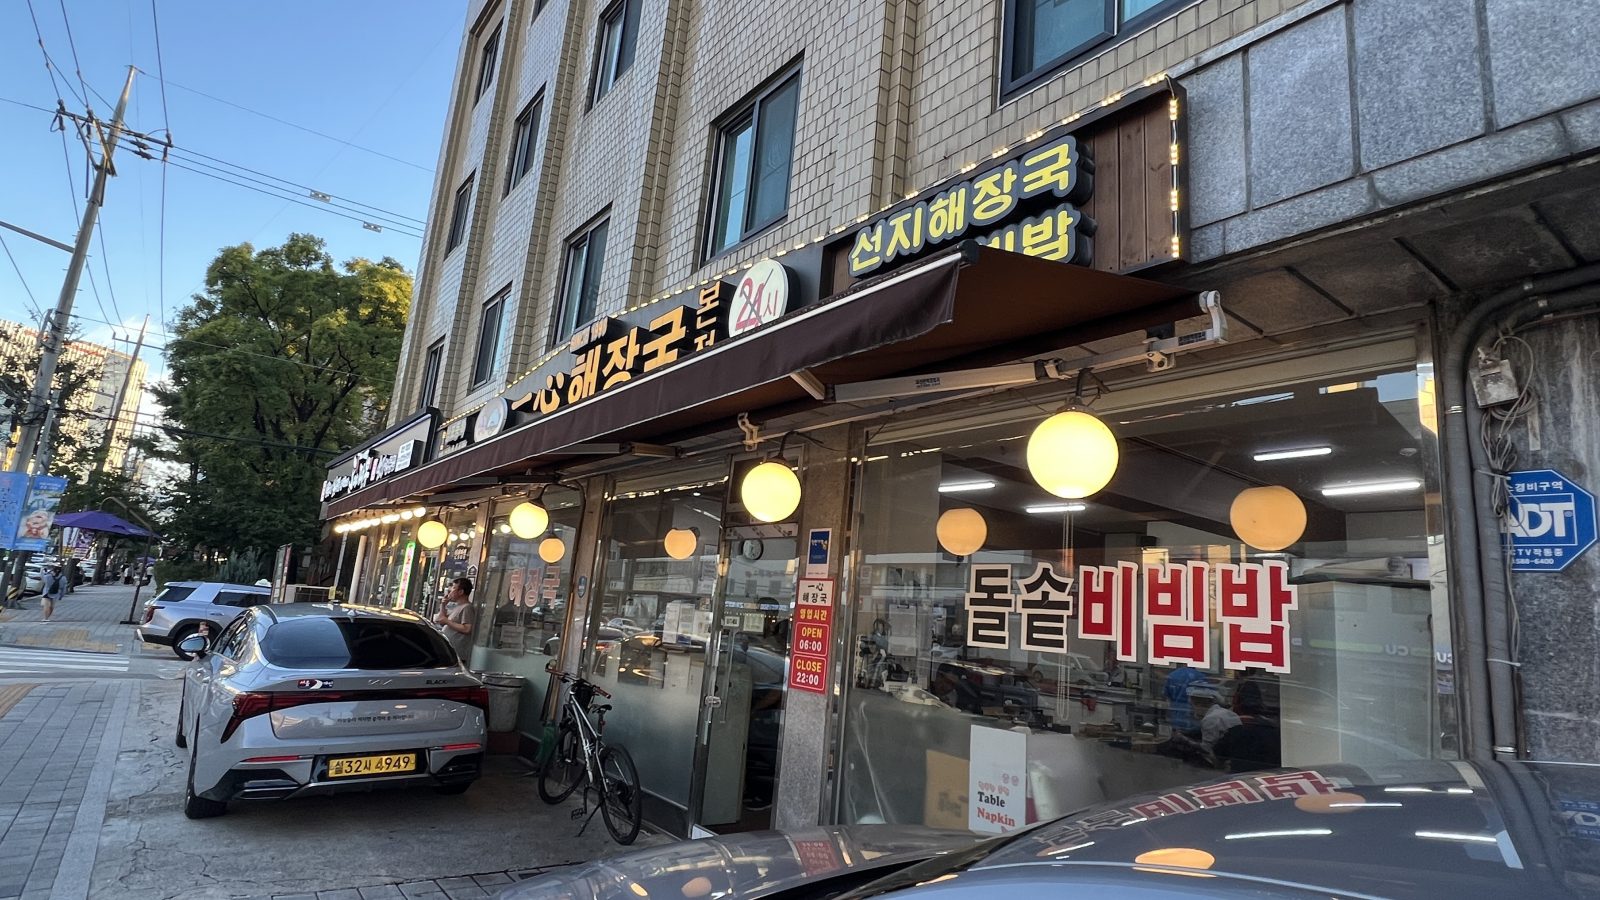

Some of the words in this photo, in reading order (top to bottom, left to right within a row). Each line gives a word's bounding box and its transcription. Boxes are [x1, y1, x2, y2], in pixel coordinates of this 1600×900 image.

[851, 142, 1073, 272] 선지해장국
[567, 305, 687, 405] 해장국
[1509, 481, 1563, 493] 경비구역
[801, 627, 823, 638] OPEN
[799, 639, 822, 652] 06:00
[796, 659, 822, 673] CLOSE
[796, 672, 819, 686] 22:00
[375, 756, 410, 771] 4949
[977, 791, 1006, 808] Table
[977, 807, 1016, 827] Napkin
